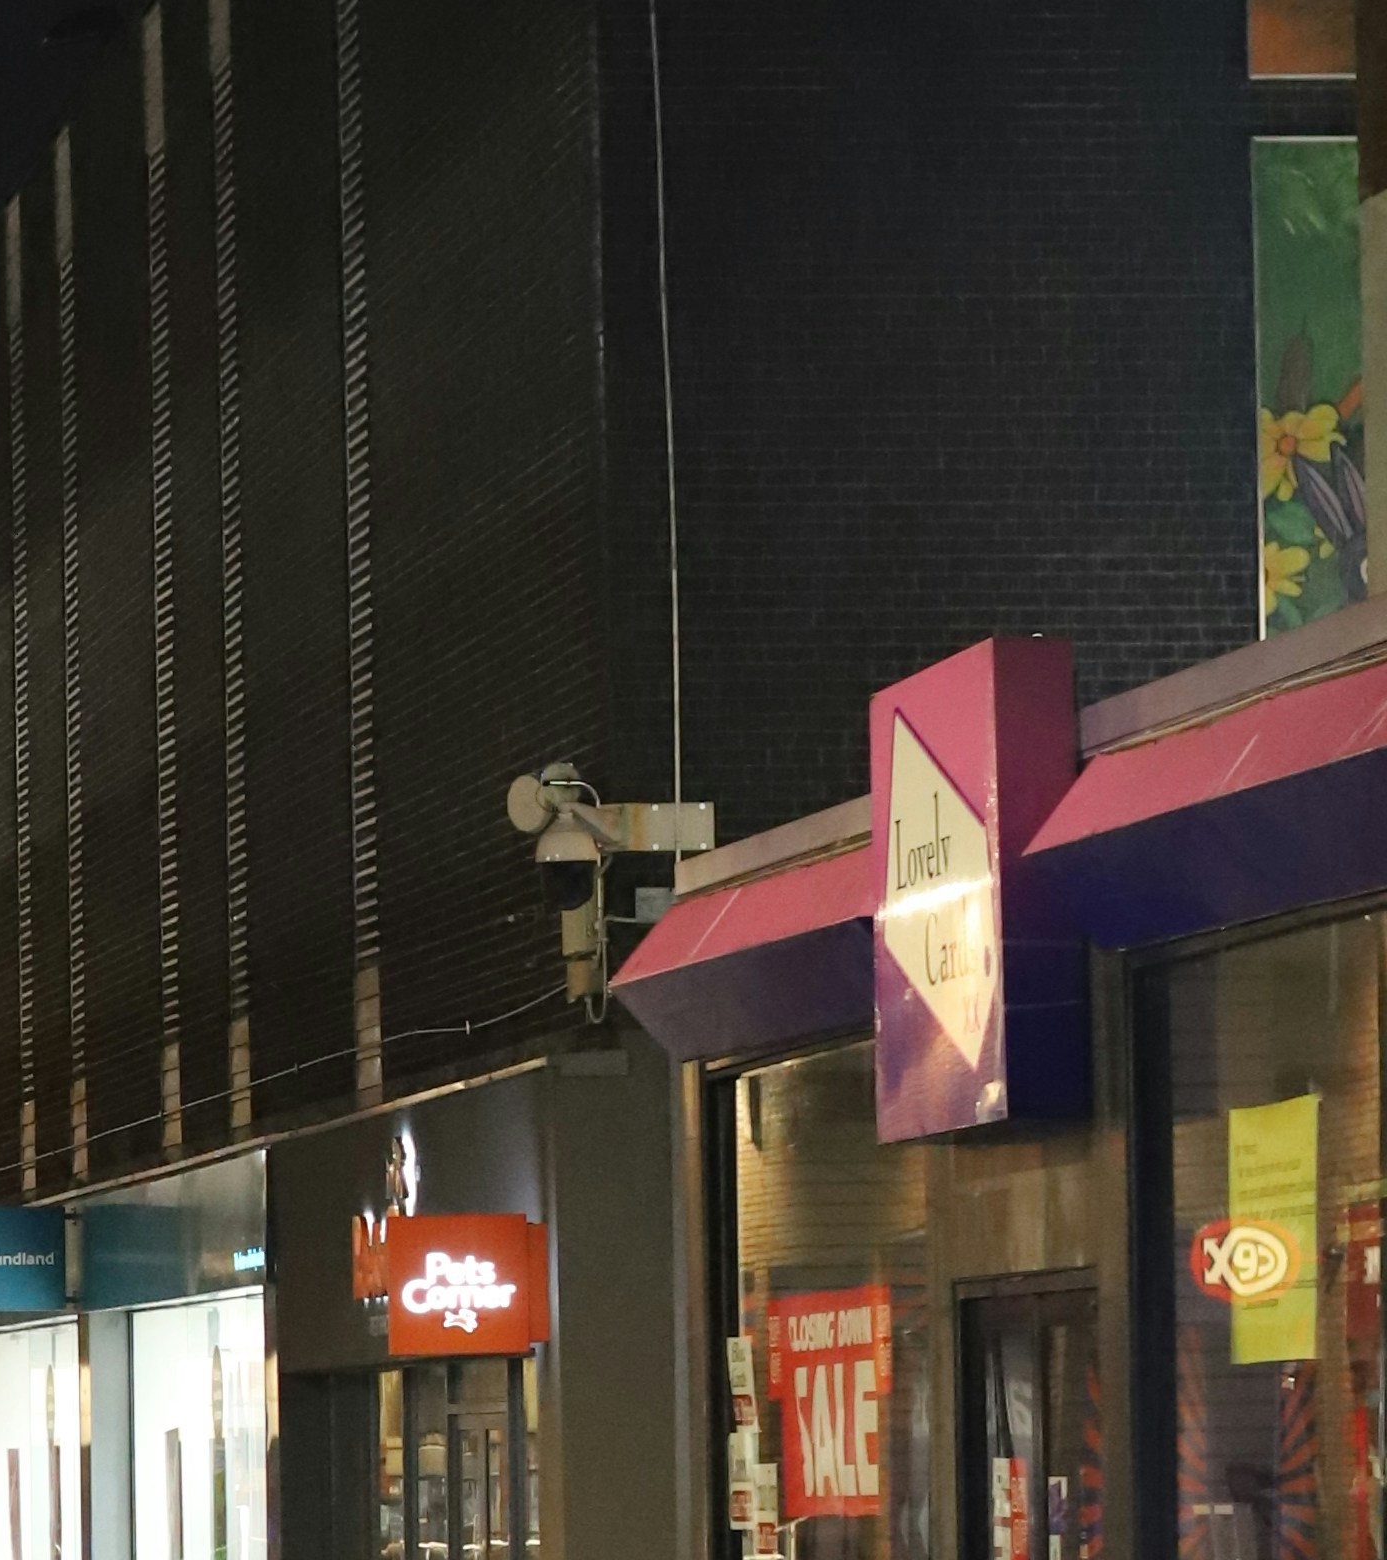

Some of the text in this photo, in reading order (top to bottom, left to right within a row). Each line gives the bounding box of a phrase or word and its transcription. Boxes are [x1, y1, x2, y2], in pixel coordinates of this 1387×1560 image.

[894, 791, 952, 891] Lovely
[425, 1252, 496, 1286] Pets
[401, 1278, 517, 1314] Corner
[788, 1311, 835, 1352] CLOSING
[838, 1306, 873, 1347] DOWN
[794, 1359, 879, 1497] SALE
